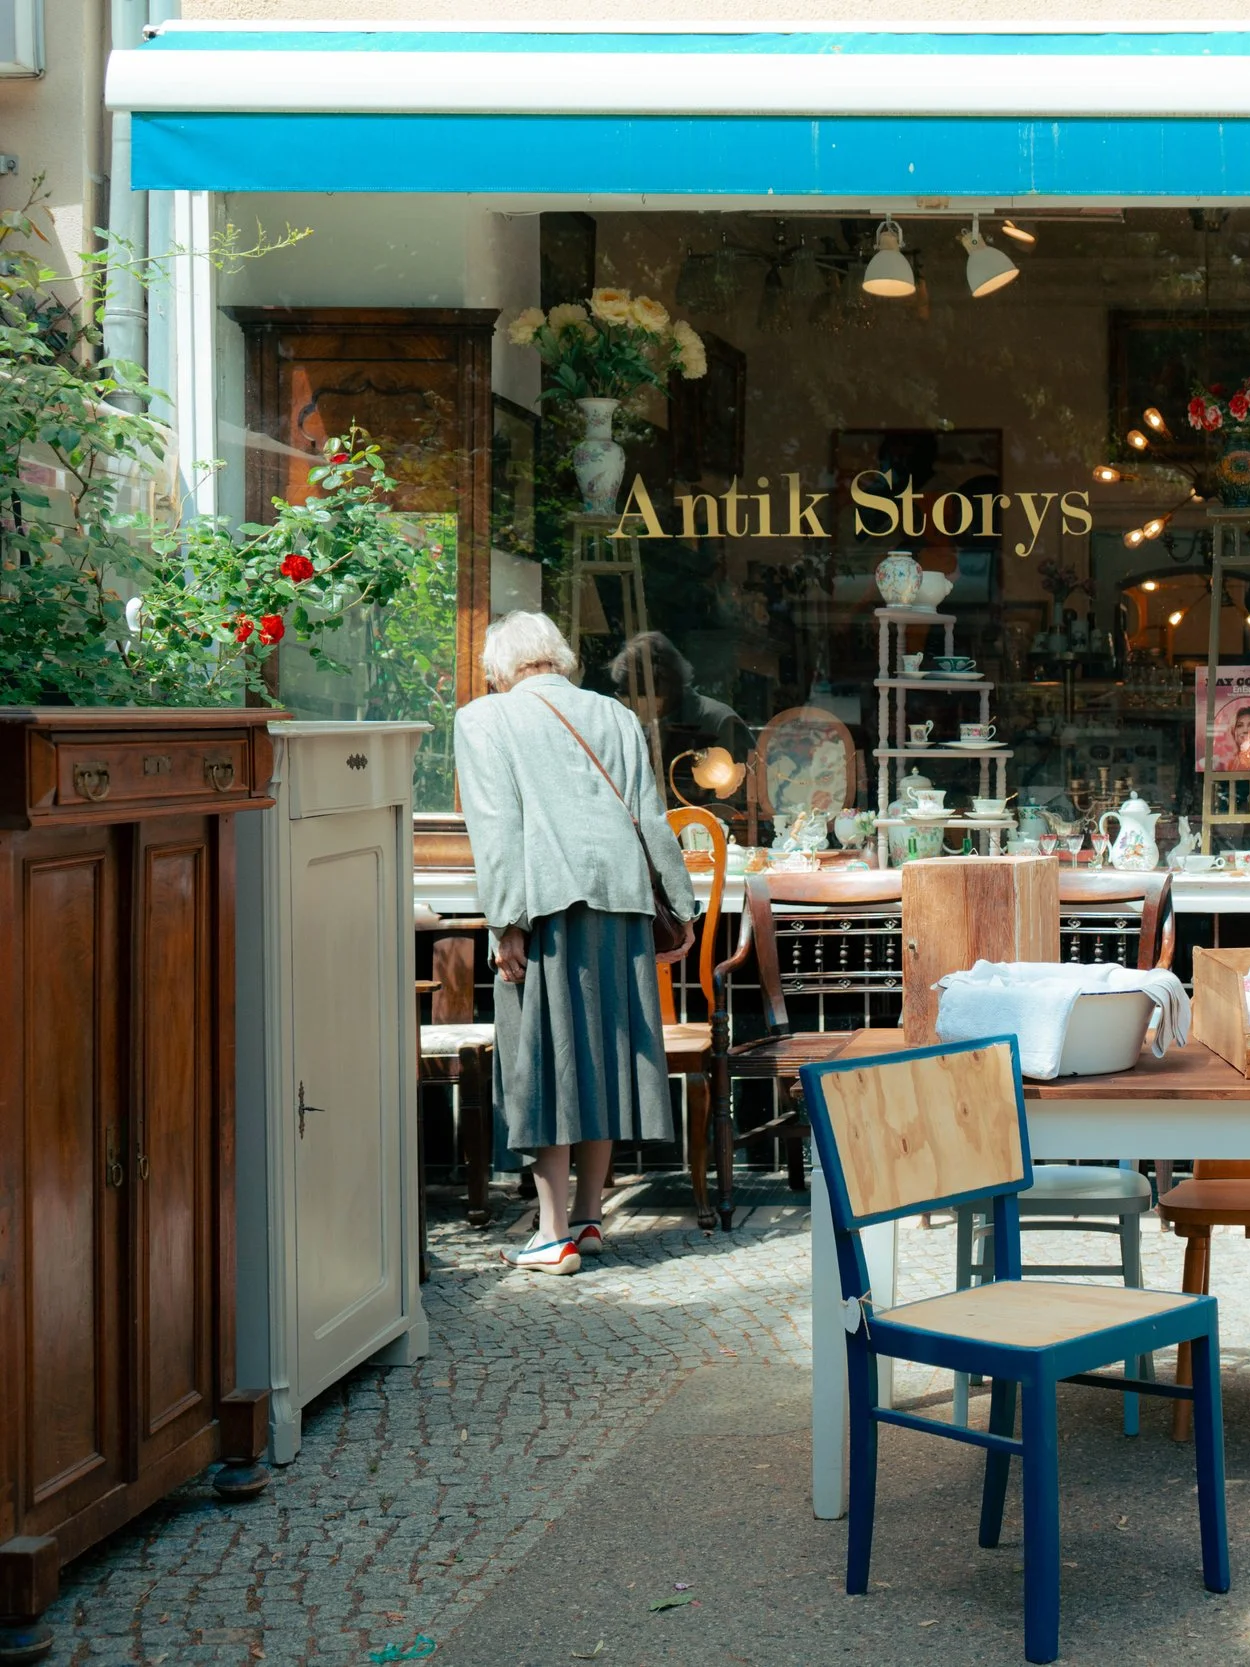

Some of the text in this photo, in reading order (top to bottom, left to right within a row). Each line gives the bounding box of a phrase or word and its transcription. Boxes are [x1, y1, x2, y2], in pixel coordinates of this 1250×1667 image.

[607, 470, 1093, 558] Antik Storys
[1205, 677, 1233, 686] AY
